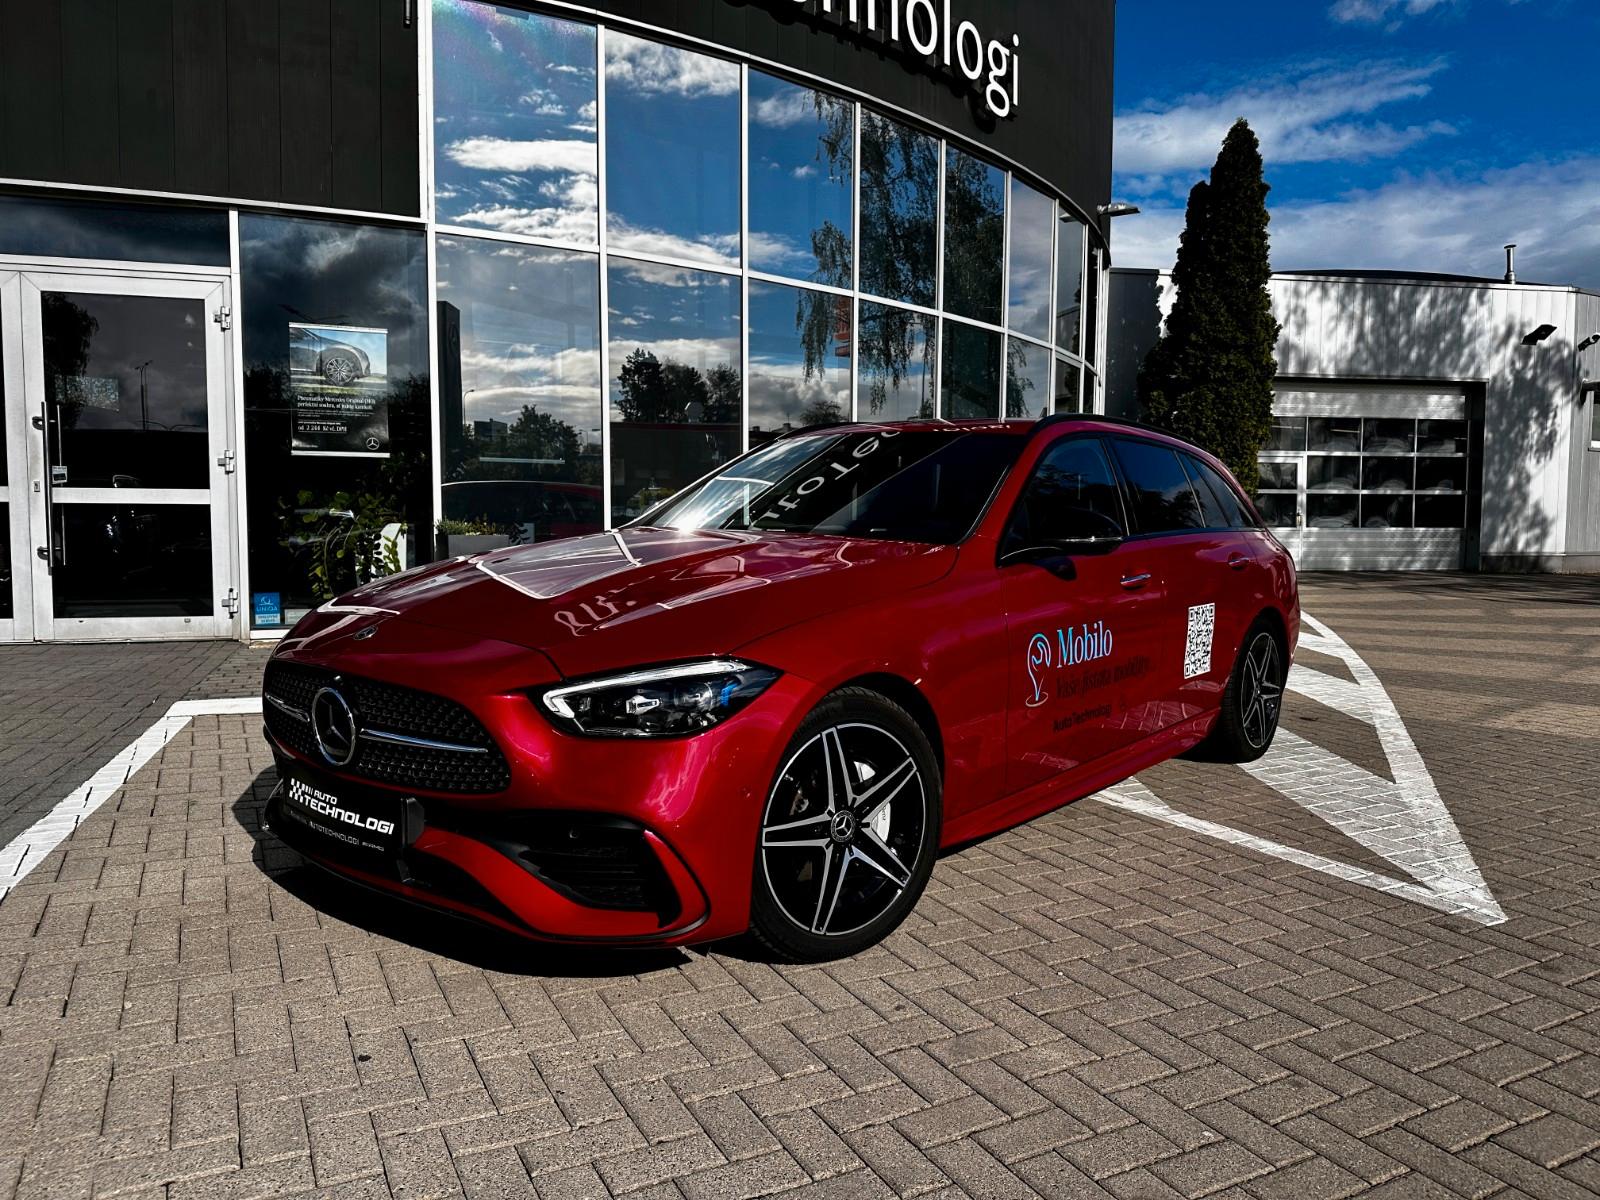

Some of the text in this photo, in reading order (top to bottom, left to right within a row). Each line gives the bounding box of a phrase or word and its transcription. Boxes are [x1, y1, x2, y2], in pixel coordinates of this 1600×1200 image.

[1056, 620, 1113, 669] Mobilo
[304, 794, 395, 835] TECHNOLOGI
[313, 789, 338, 805] AUTO
